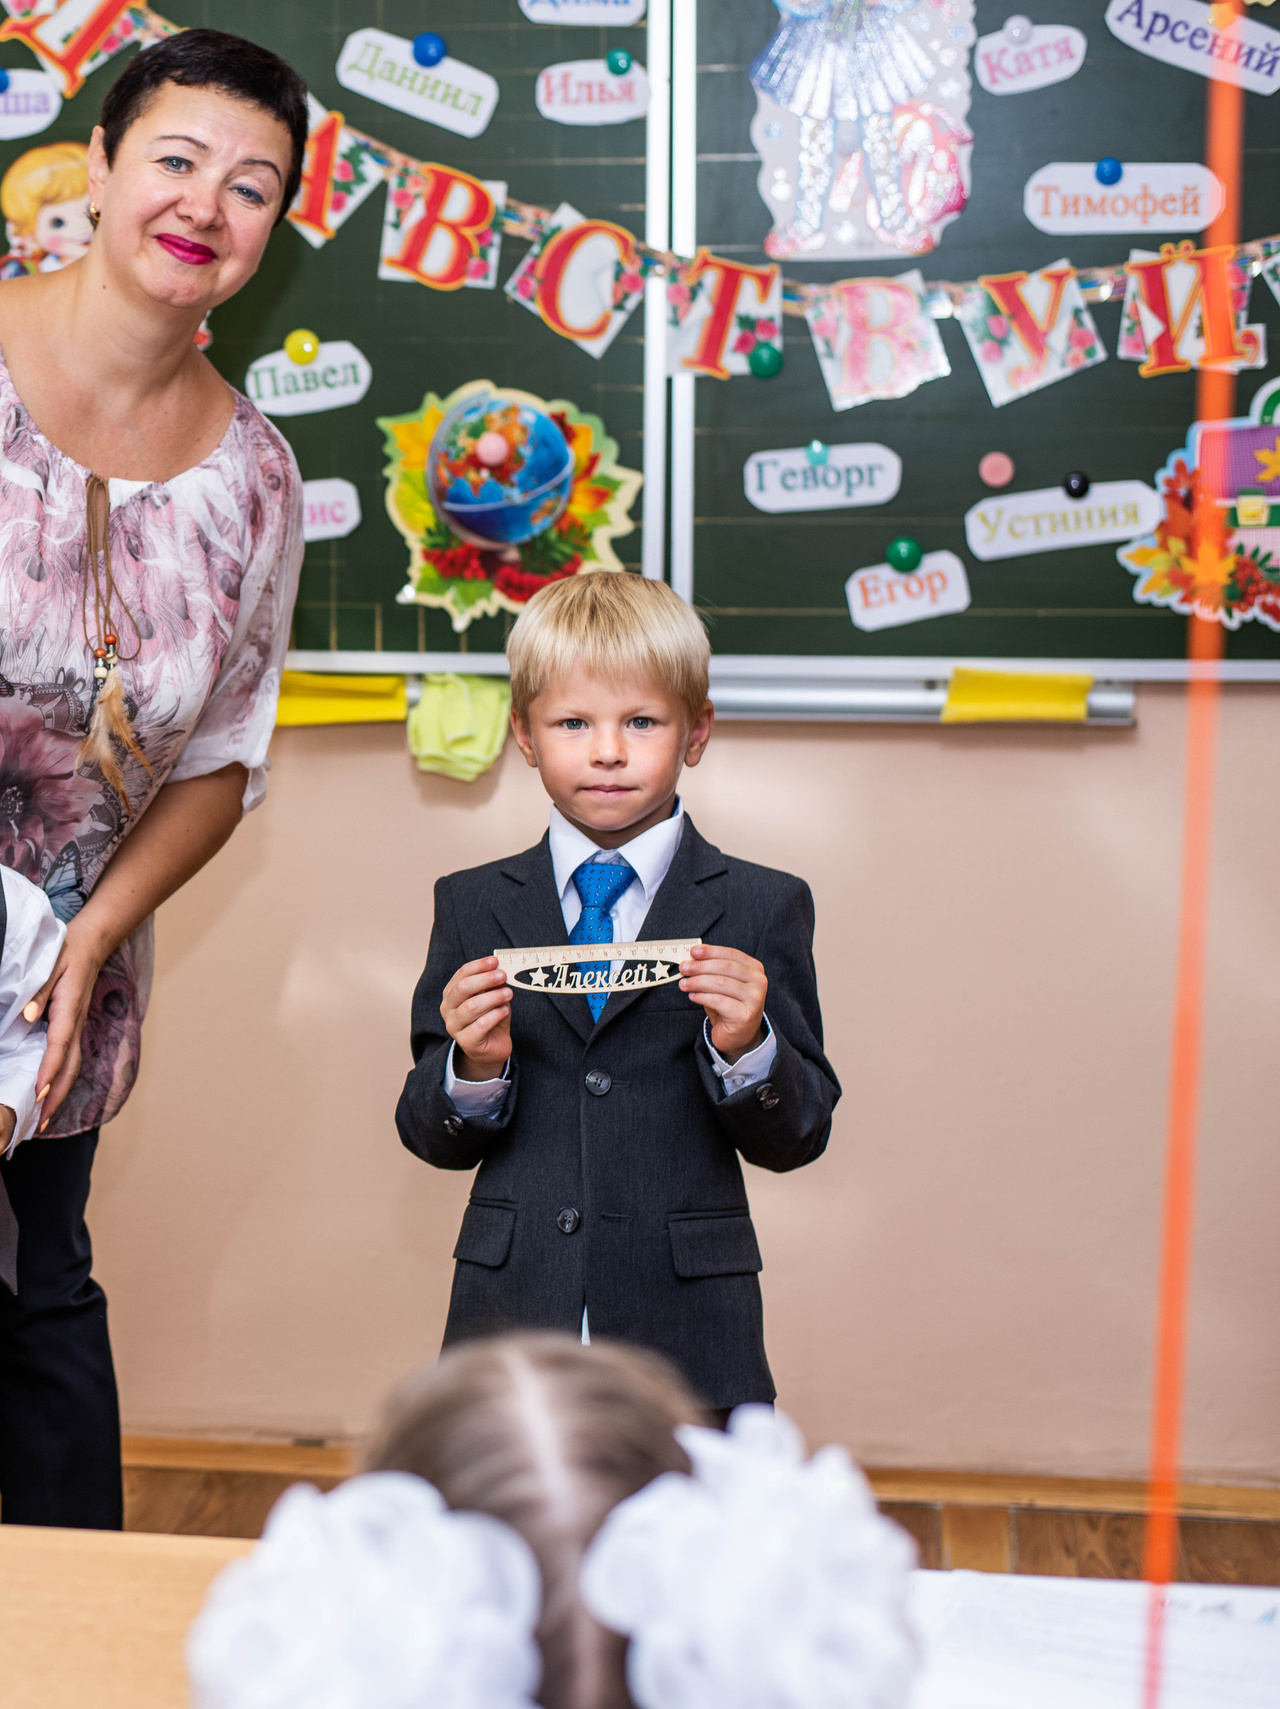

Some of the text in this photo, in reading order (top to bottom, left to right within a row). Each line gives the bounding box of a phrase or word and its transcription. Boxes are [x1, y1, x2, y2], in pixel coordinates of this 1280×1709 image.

[1118, 0, 1280, 78] Арсений
[346, 41, 485, 117] Даниил
[981, 37, 1076, 86] Катя
[541, 71, 635, 105] Илья
[1033, 184, 1203, 226] Тимофей
[251, 362, 361, 400] Павел
[754, 460, 884, 497] Геворг
[976, 501, 1141, 544] Устиния
[856, 569, 949, 610] Егор
[547, 963, 651, 989] Алексей
